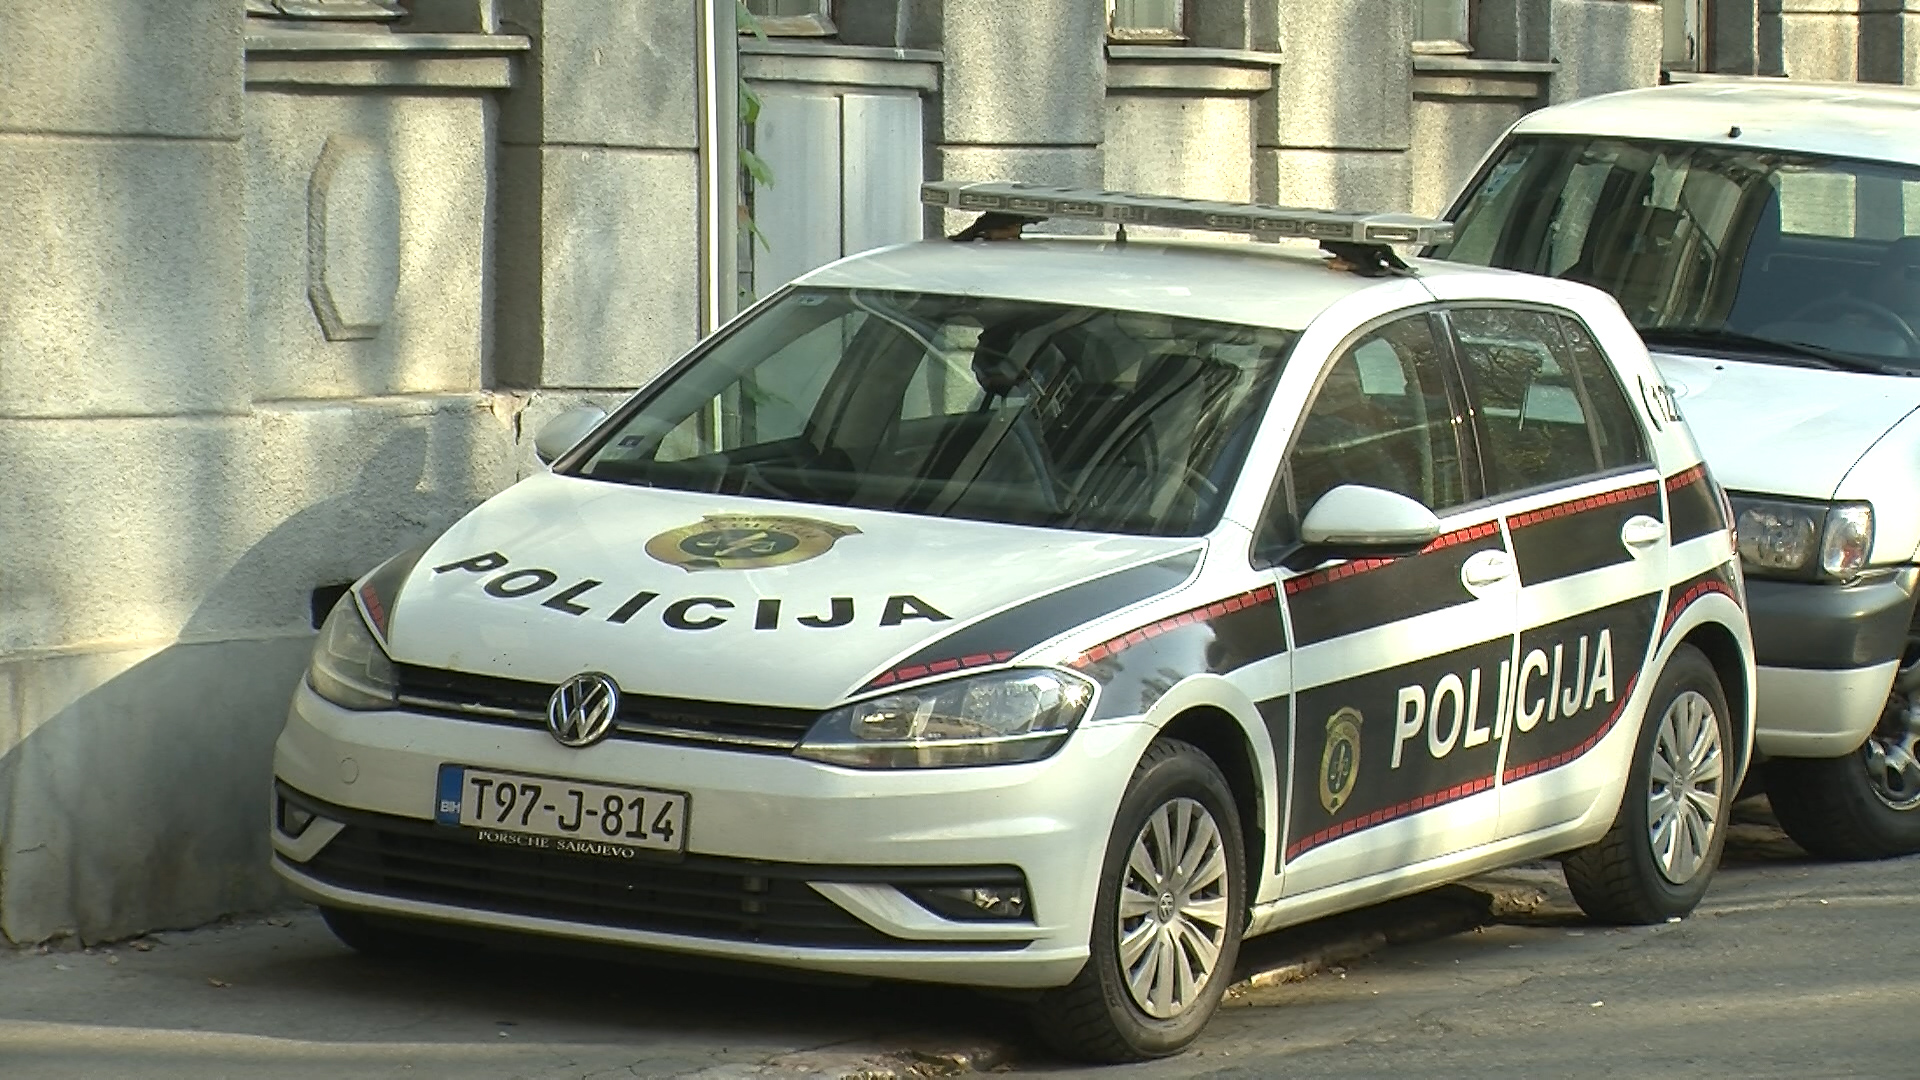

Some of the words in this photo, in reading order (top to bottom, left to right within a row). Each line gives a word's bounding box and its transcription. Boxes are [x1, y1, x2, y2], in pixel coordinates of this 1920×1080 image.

[432, 551, 953, 631] POLICIJA
[1390, 628, 1615, 770] POLICIJA
[470, 777, 675, 842] T97-J-814
[478, 829, 550, 849] PORSCHE
[556, 839, 635, 859] SARAJEVO
